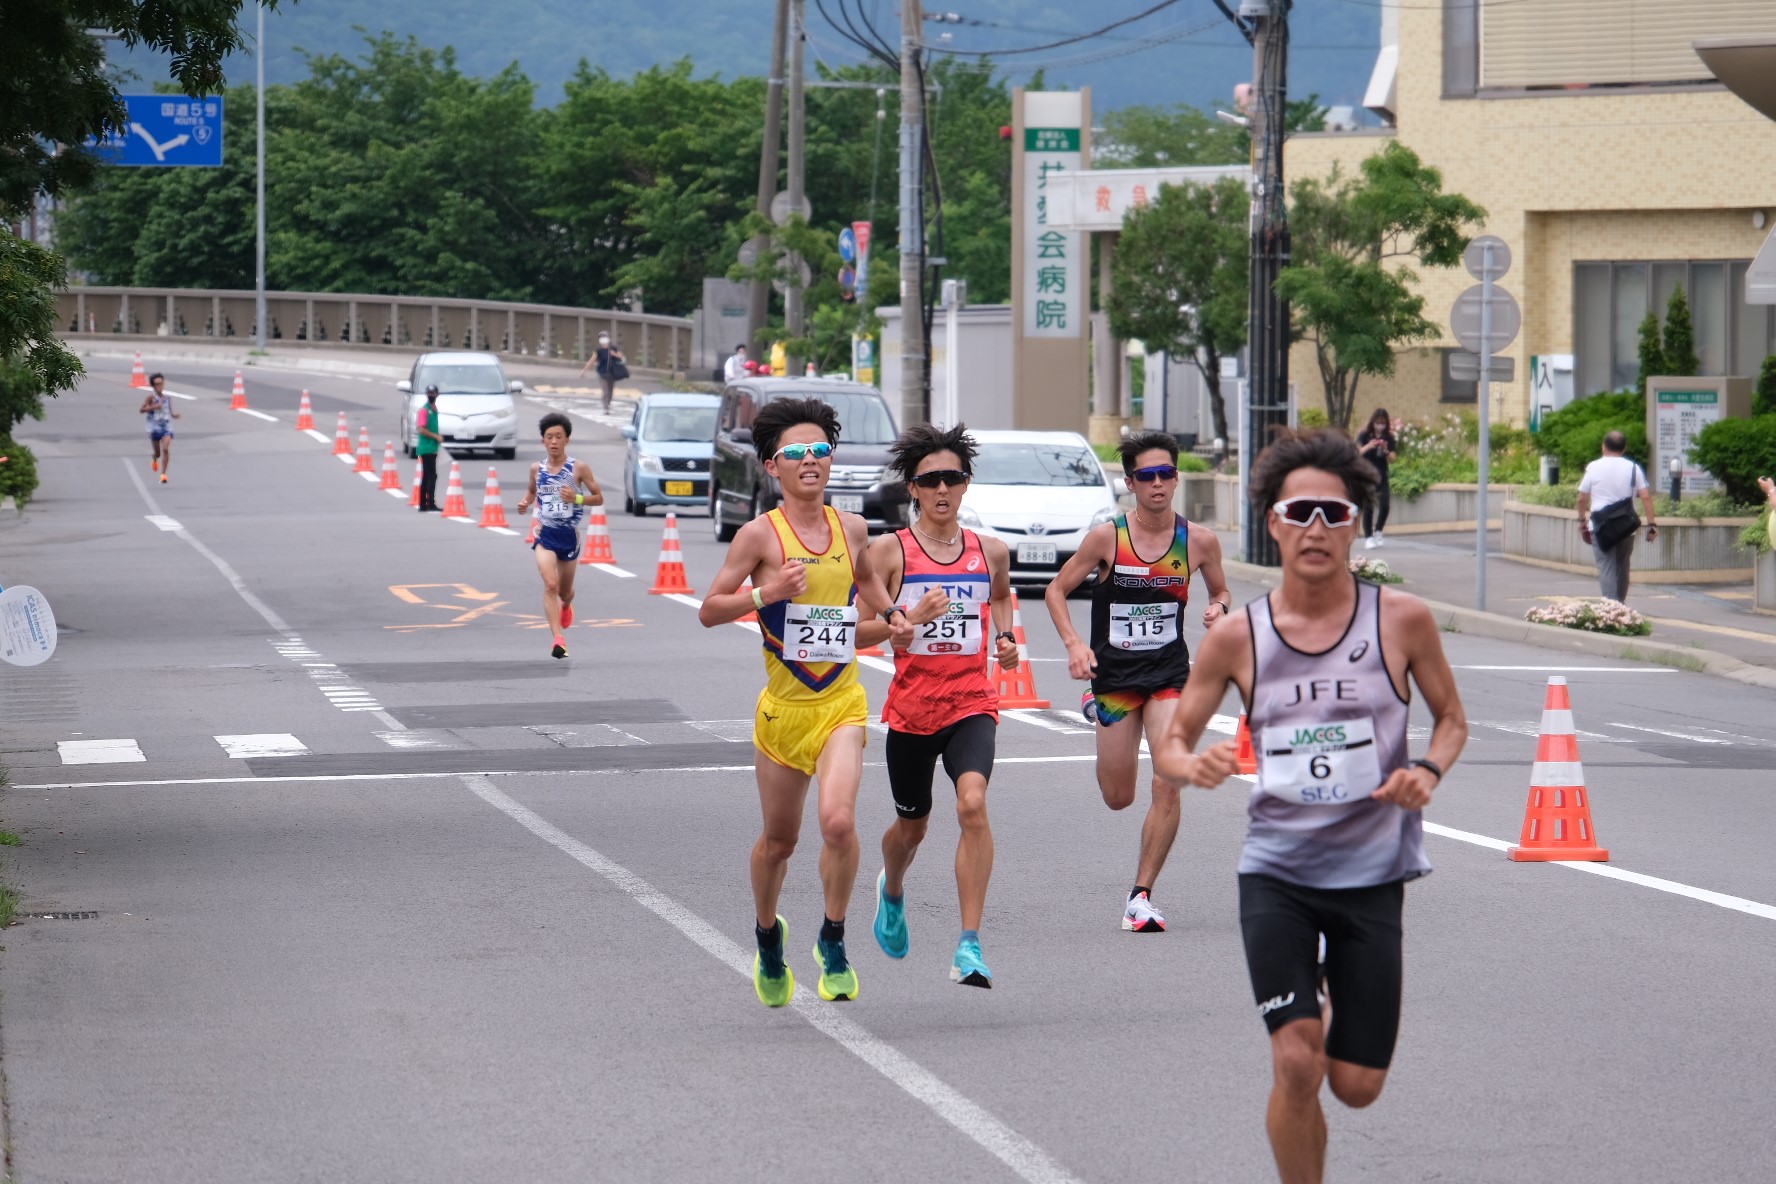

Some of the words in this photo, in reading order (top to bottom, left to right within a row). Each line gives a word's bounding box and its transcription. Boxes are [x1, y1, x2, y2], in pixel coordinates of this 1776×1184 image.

[161, 103, 217, 117] 国道5号
[548, 503, 569, 511] 215
[1026, 552, 1053, 561] 88-80
[1113, 575, 1185, 587] KOMORI
[806, 607, 844, 620] JACCS
[1128, 605, 1162, 616] JACCS
[799, 626, 847, 645] 244
[922, 621, 966, 638] 251
[1125, 620, 1164, 637] 115
[931, 644, 959, 652] 第一生命
[1285, 679, 1359, 707] JFE
[1289, 726, 1347, 746] JACCS
[1310, 755, 1331, 779] 6
[1301, 783, 1348, 802] SEC
